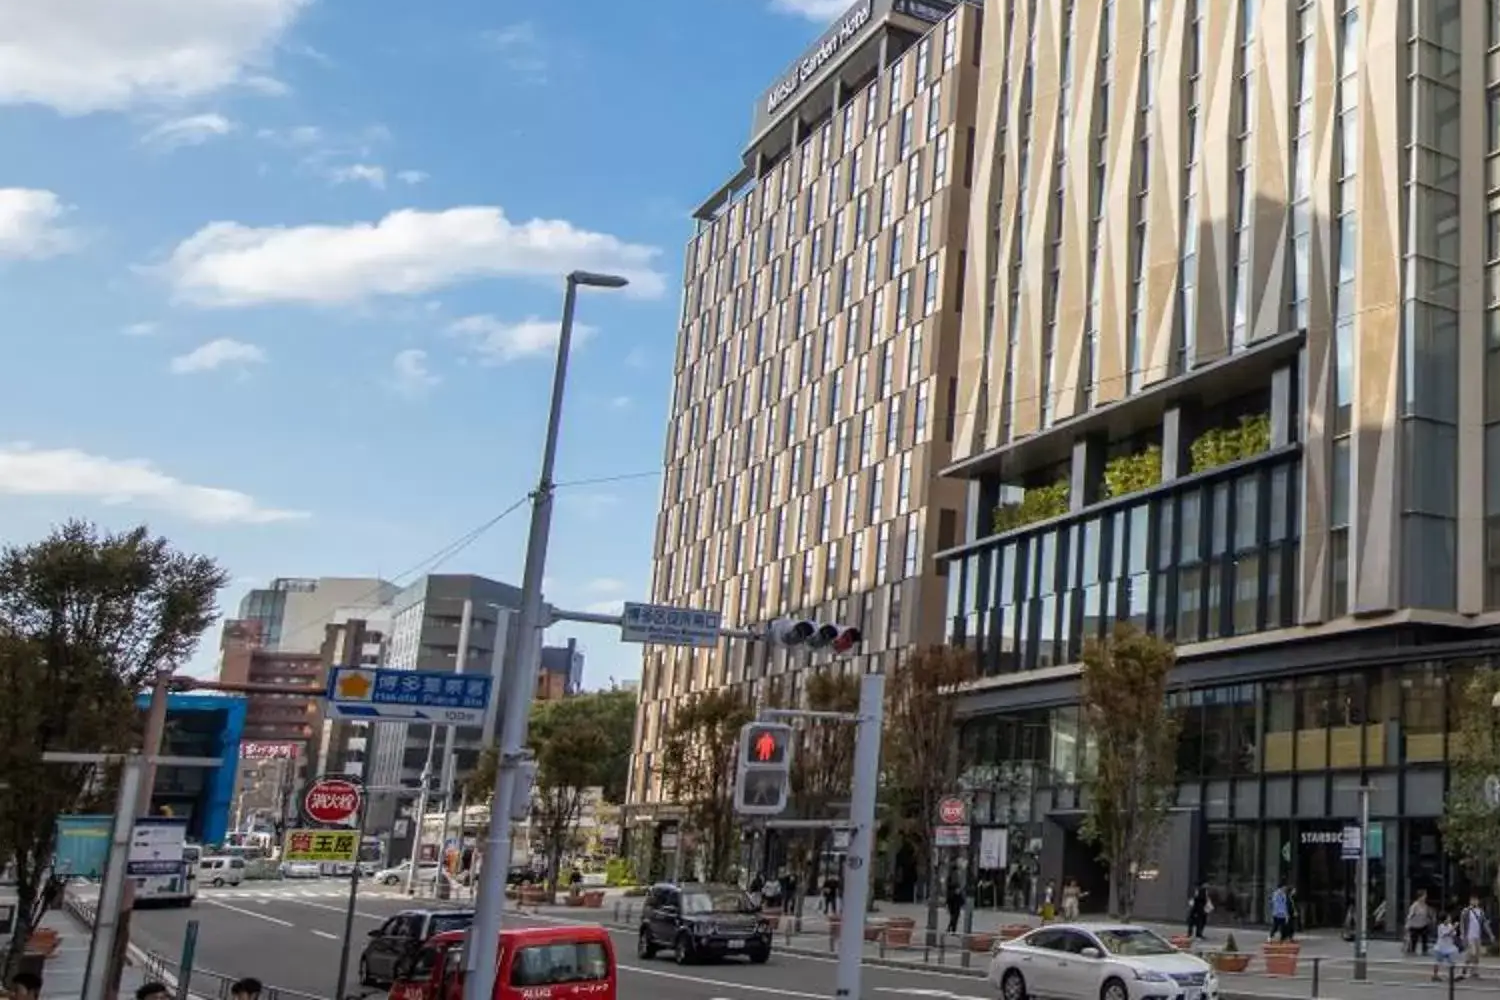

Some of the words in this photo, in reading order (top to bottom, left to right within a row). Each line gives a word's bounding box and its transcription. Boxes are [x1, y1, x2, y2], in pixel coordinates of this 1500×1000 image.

[801, 35, 840, 82] Garden
[311, 793, 355, 810] 消火栓
[1301, 831, 1343, 844] STARBUC
